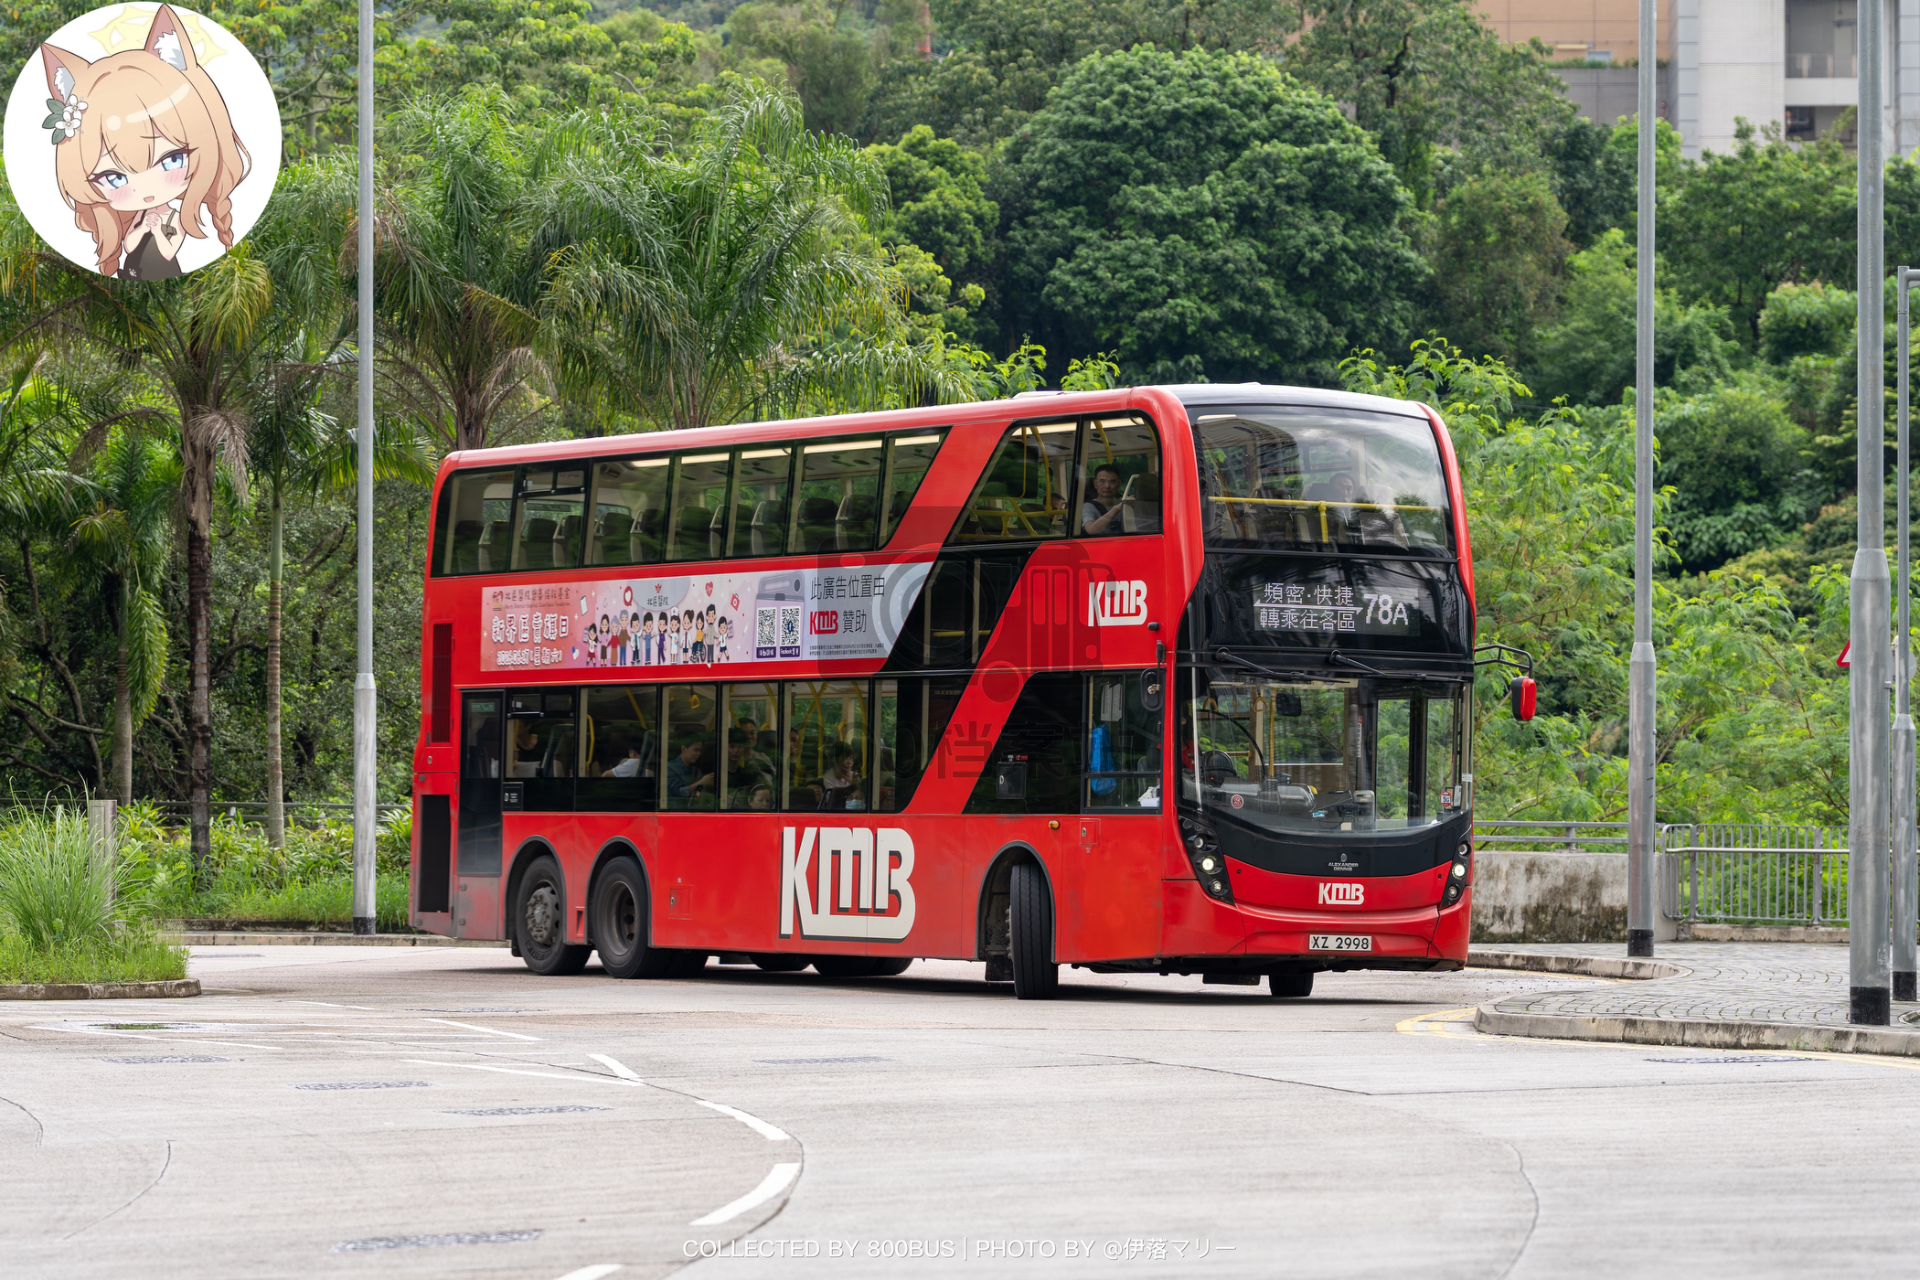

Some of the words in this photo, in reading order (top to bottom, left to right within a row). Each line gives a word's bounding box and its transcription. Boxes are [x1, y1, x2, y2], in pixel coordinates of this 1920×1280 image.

[810, 574, 885, 600] 此廣告位置由
[1088, 580, 1147, 627] KMB
[1363, 594, 1409, 626] 78A
[492, 612, 568, 643] 新界區賣旗日
[810, 610, 839, 635] KMB
[1259, 608, 1356, 632] 轉乘往各區
[779, 826, 916, 943] KMB
[1318, 883, 1364, 905] KMB
[1311, 936, 1329, 949] XZ
[1335, 936, 1369, 950] 2998
